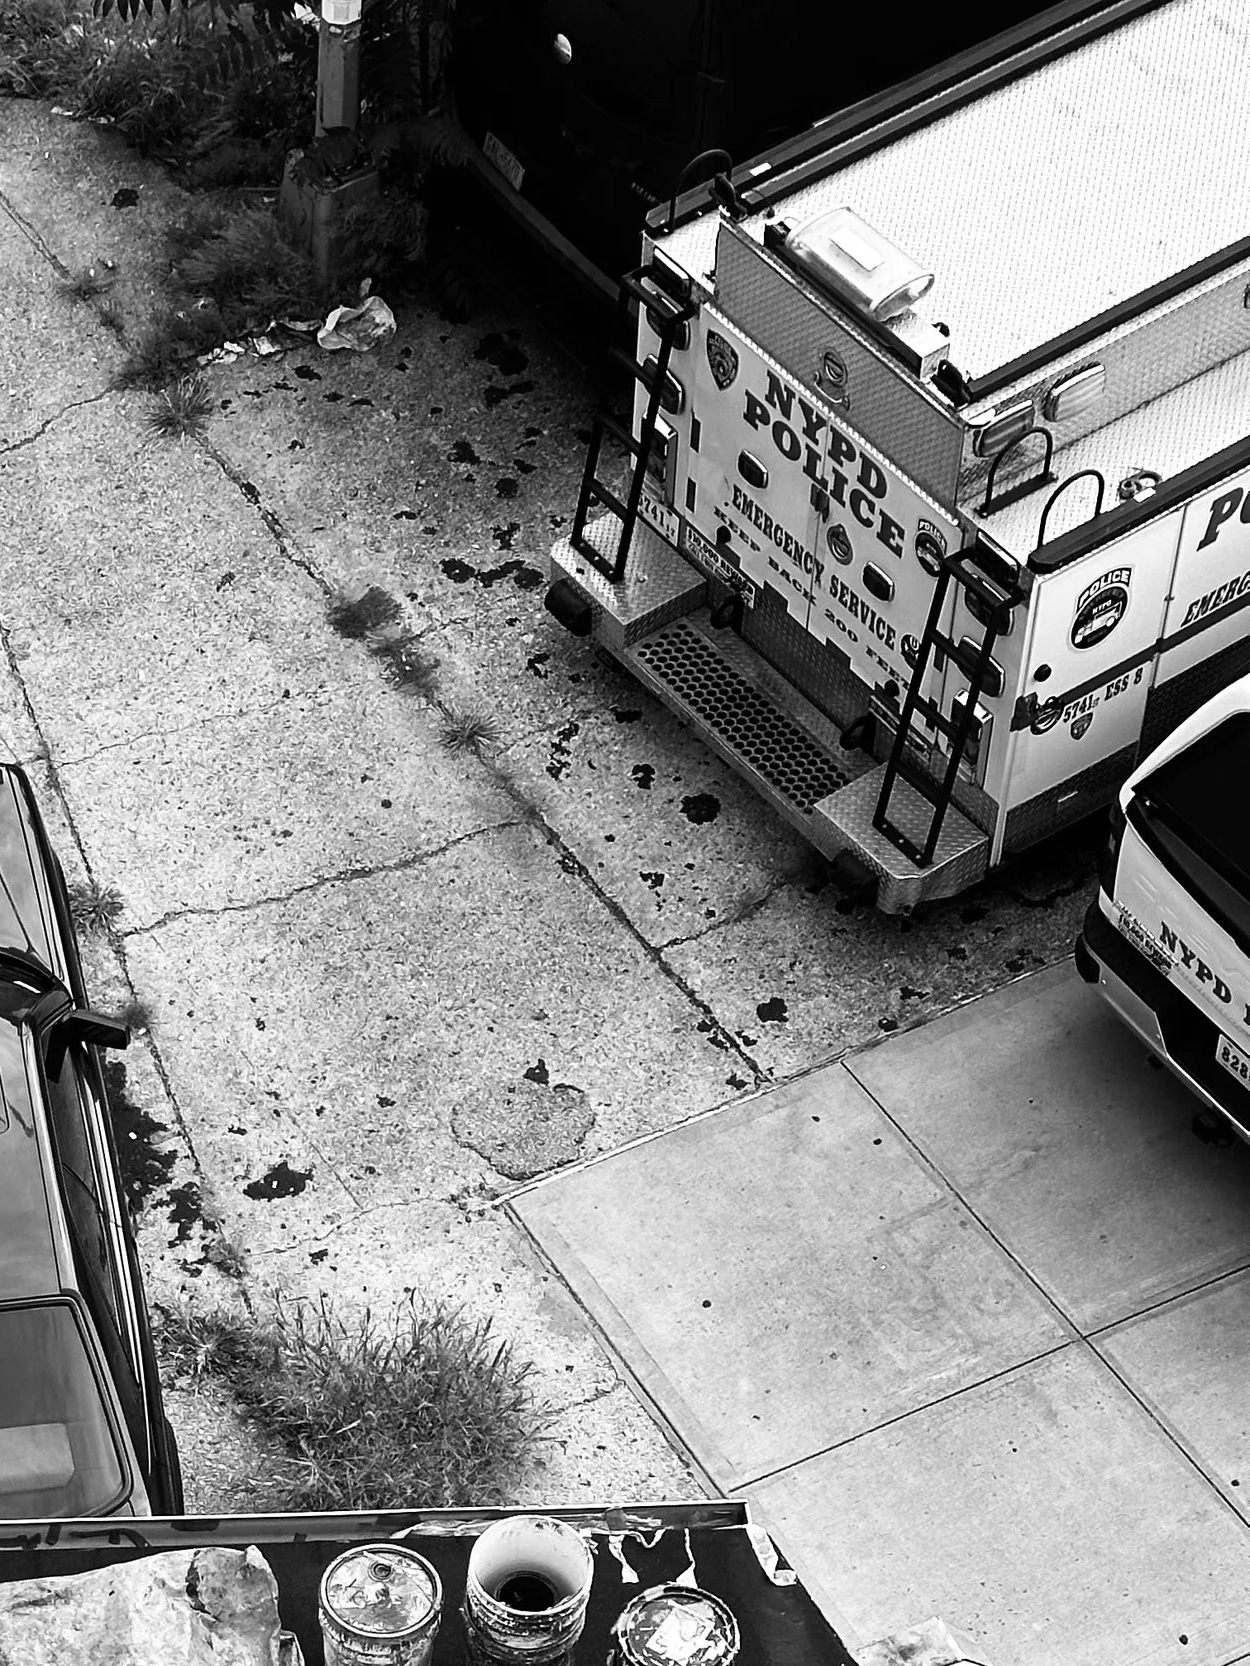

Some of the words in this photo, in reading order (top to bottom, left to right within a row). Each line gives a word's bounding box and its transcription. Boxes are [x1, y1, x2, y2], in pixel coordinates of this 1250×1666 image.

[743, 389, 905, 559] POLICE
[765, 370, 887, 499] NYPD
[639, 493, 664, 527] 741
[732, 484, 824, 588] EMERGENCY
[830, 575, 896, 650] SERVICE
[768, 556, 817, 606] BACK
[824, 609, 858, 642] 200
[1079, 570, 1130, 608] POLICE
[1063, 694, 1093, 723] 5741
[1104, 675, 1129, 701] ESS
[1134, 667, 1143, 684] 8
[1159, 921, 1231, 1004] NYPD
[1222, 1046, 1250, 1084] 828
